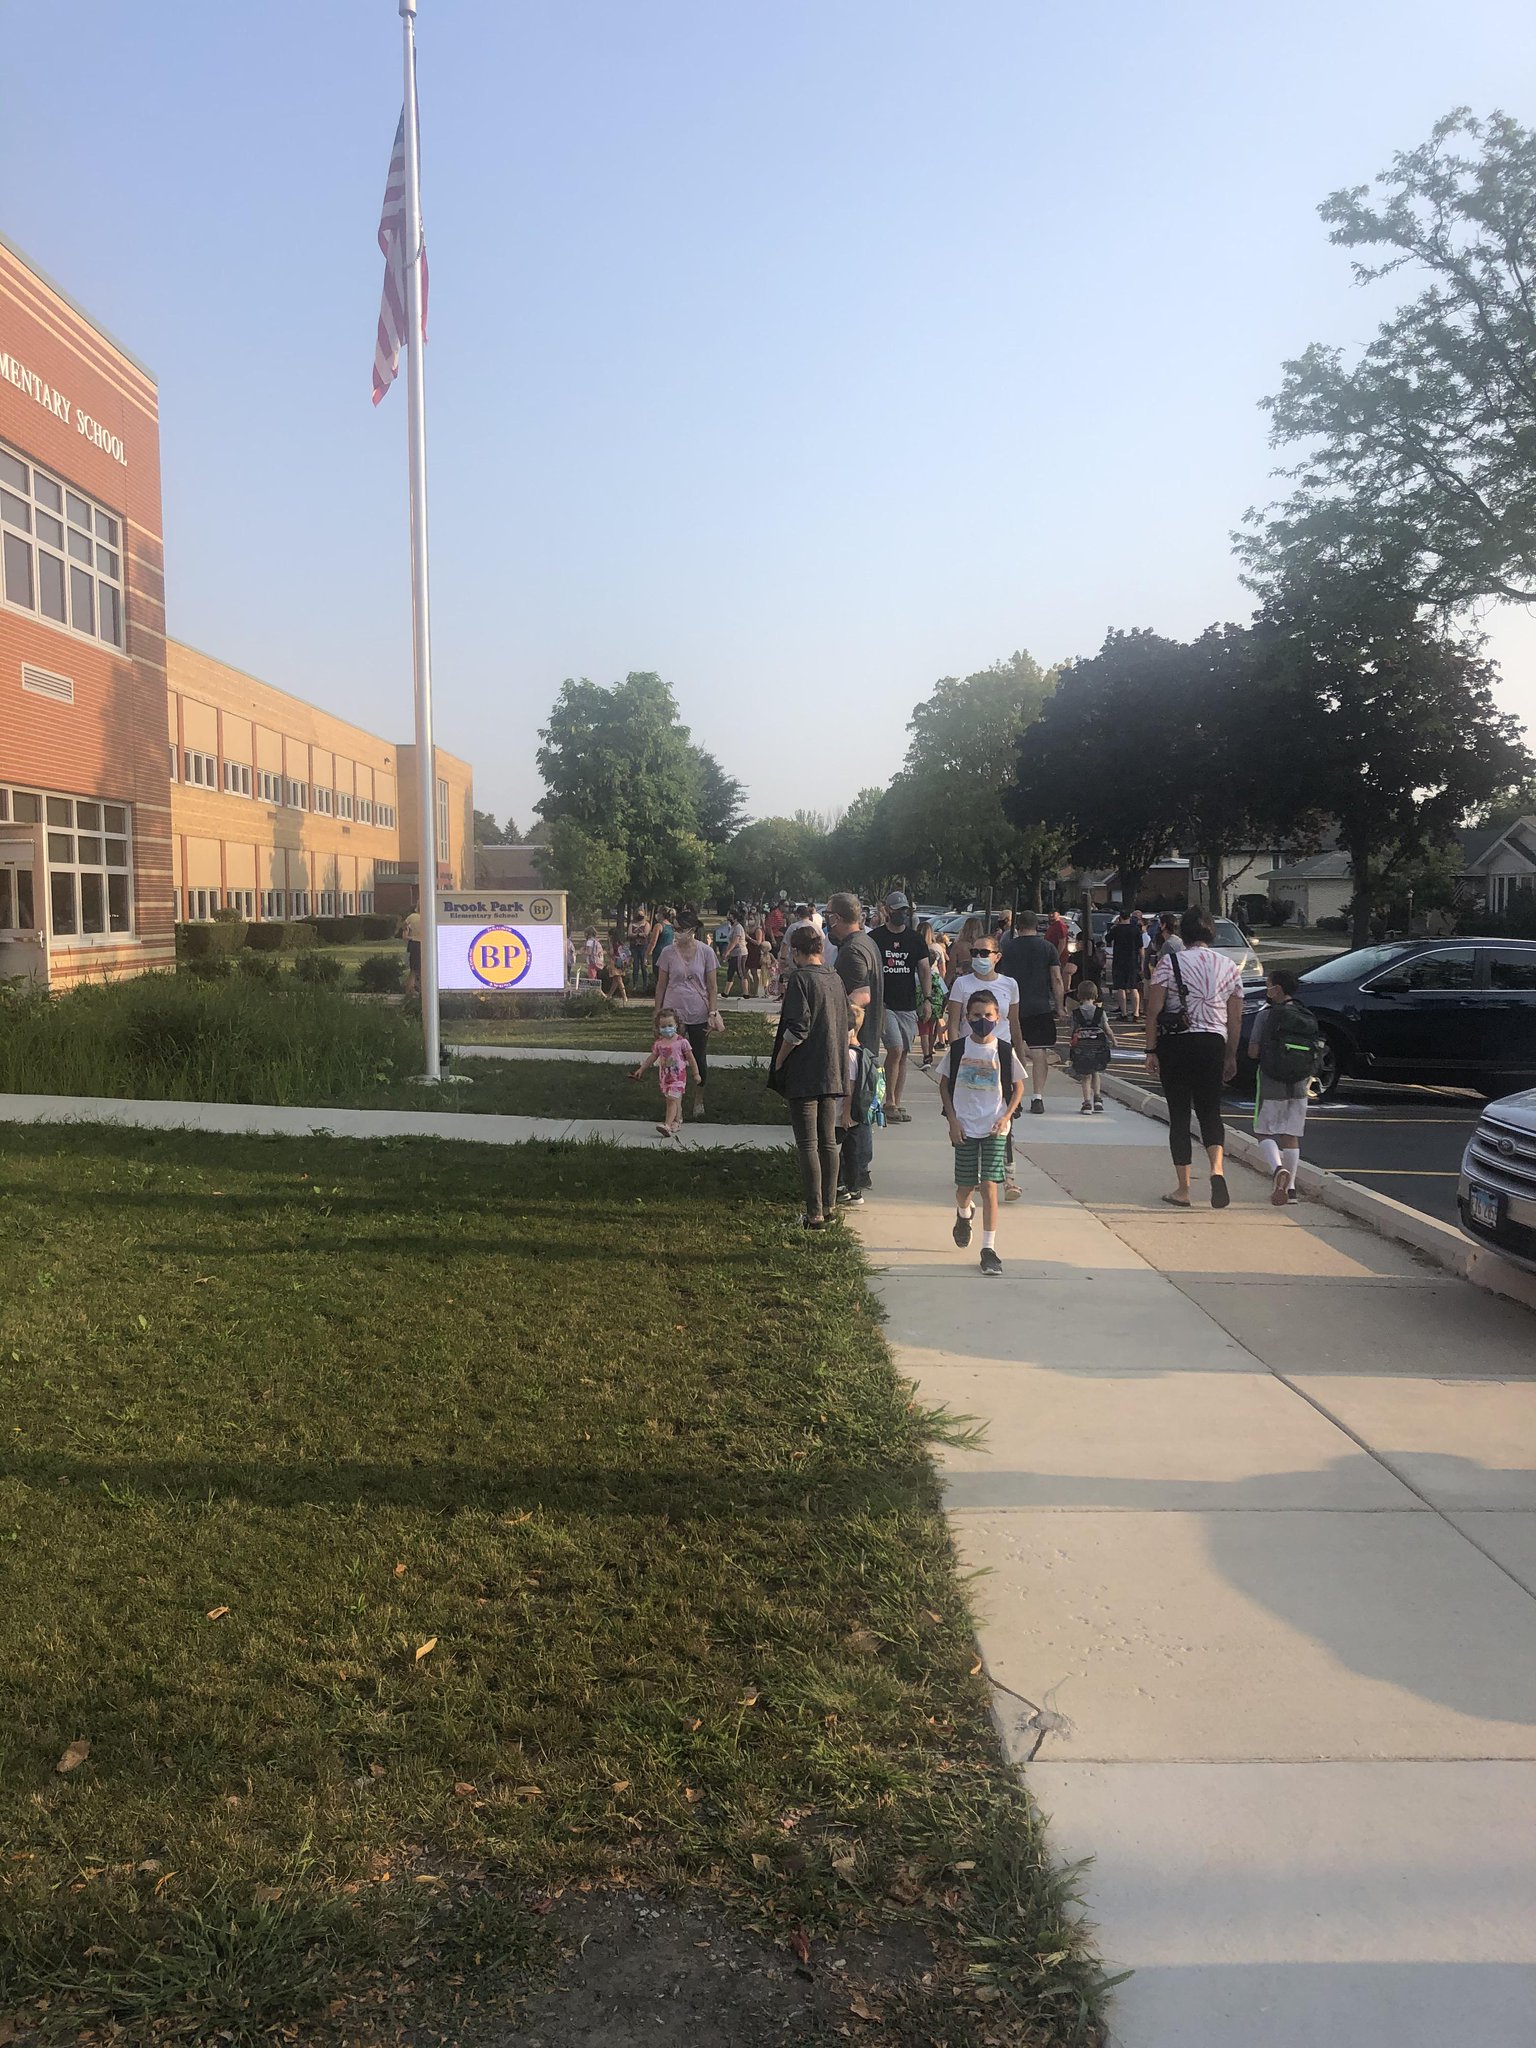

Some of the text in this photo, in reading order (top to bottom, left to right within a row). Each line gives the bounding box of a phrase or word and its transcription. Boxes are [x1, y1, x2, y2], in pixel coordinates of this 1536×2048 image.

[76, 408, 128, 467] SCHOOL
[443, 901, 524, 912] Brook Park
[534, 905, 549, 915] BP
[480, 945, 521, 969] BP
[885, 950, 909, 959] Every
